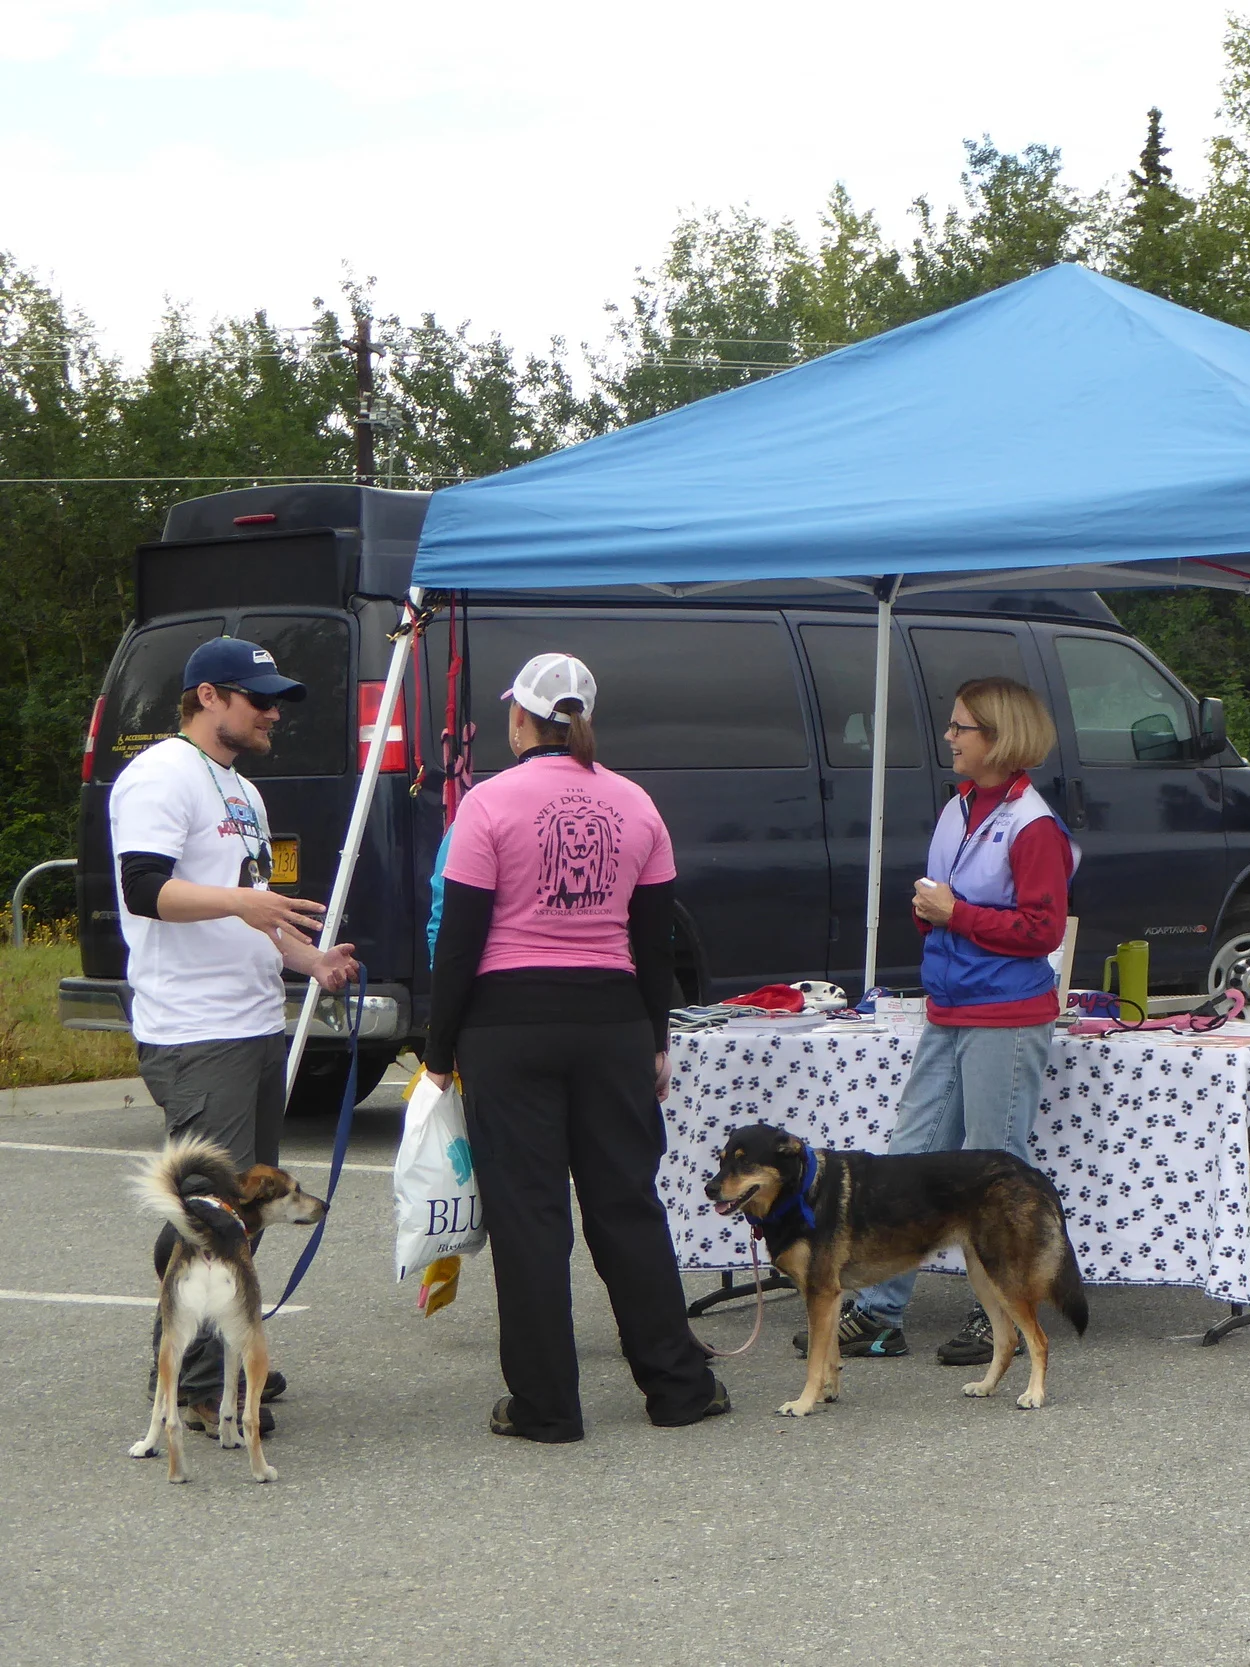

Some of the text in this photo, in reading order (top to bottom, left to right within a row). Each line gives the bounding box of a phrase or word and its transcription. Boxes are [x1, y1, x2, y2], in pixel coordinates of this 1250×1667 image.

[534, 801, 557, 825] WET
[560, 795, 592, 805] DOG
[277, 852, 296, 872] 130
